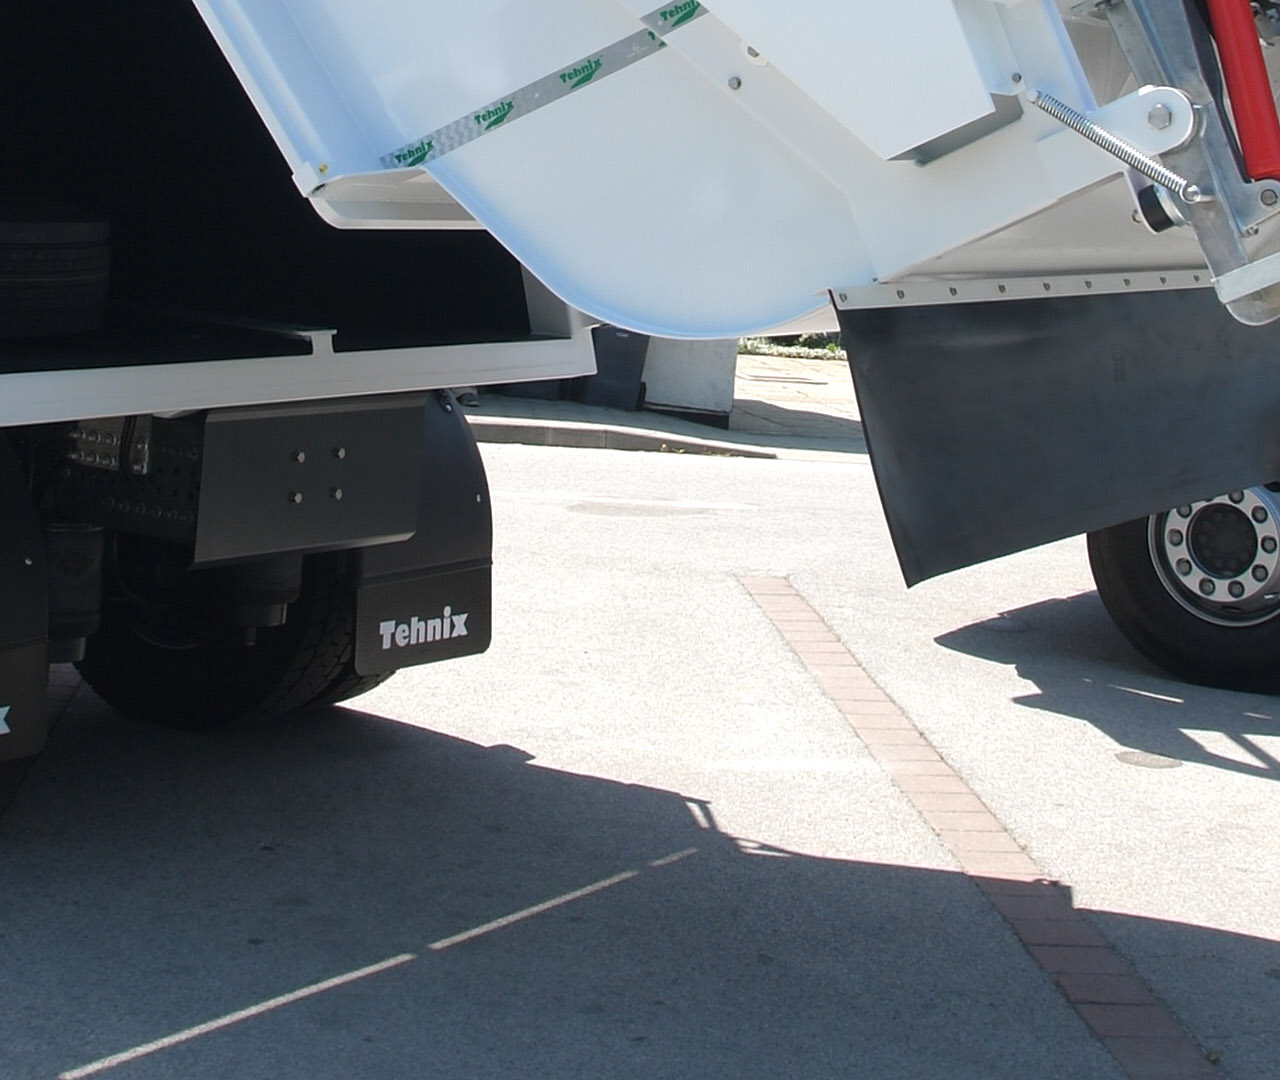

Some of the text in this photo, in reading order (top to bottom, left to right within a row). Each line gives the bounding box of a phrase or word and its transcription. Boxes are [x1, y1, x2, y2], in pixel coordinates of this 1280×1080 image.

[559, 56, 603, 83] Tehnix
[474, 99, 515, 124] Tehnix
[394, 137, 435, 164] Tehnix
[378, 605, 469, 650] Tehnix
